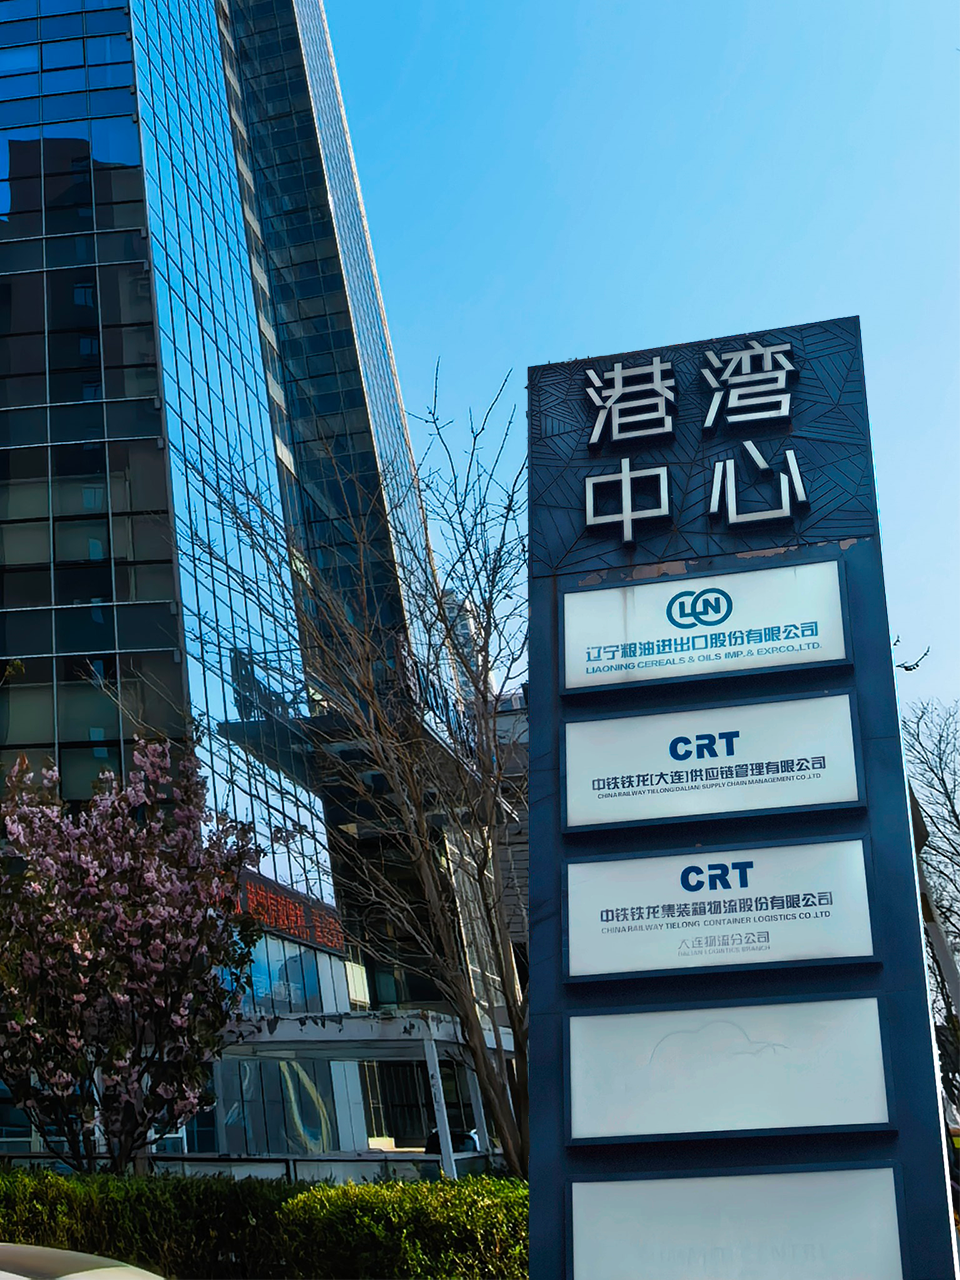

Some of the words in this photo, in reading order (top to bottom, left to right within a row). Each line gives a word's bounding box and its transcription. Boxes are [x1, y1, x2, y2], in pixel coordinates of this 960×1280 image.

[585, 340, 795, 444] 港湾
[585, 440, 808, 543] 中心
[585, 620, 819, 663] 辽宁粮油进出口股份有限公司
[585, 662, 635, 675] LIAONING
[636, 656, 685, 669] CEREALS
[697, 652, 721, 662] OILS
[668, 730, 740, 762] CRT
[701, 781, 726, 790] SUPPLY
[726, 780, 747, 788] CHAIN
[747, 775, 794, 785] MANAGEMENT
[680, 860, 754, 893] CRT
[600, 891, 834, 923] 中铁铁龙集装箱物流股份有限公司
[601, 925, 626, 934] CHINA
[627, 923, 663, 933] RAILWAY
[665, 920, 700, 930] TIELONG
[703, 916, 751, 927] CONTAINER
